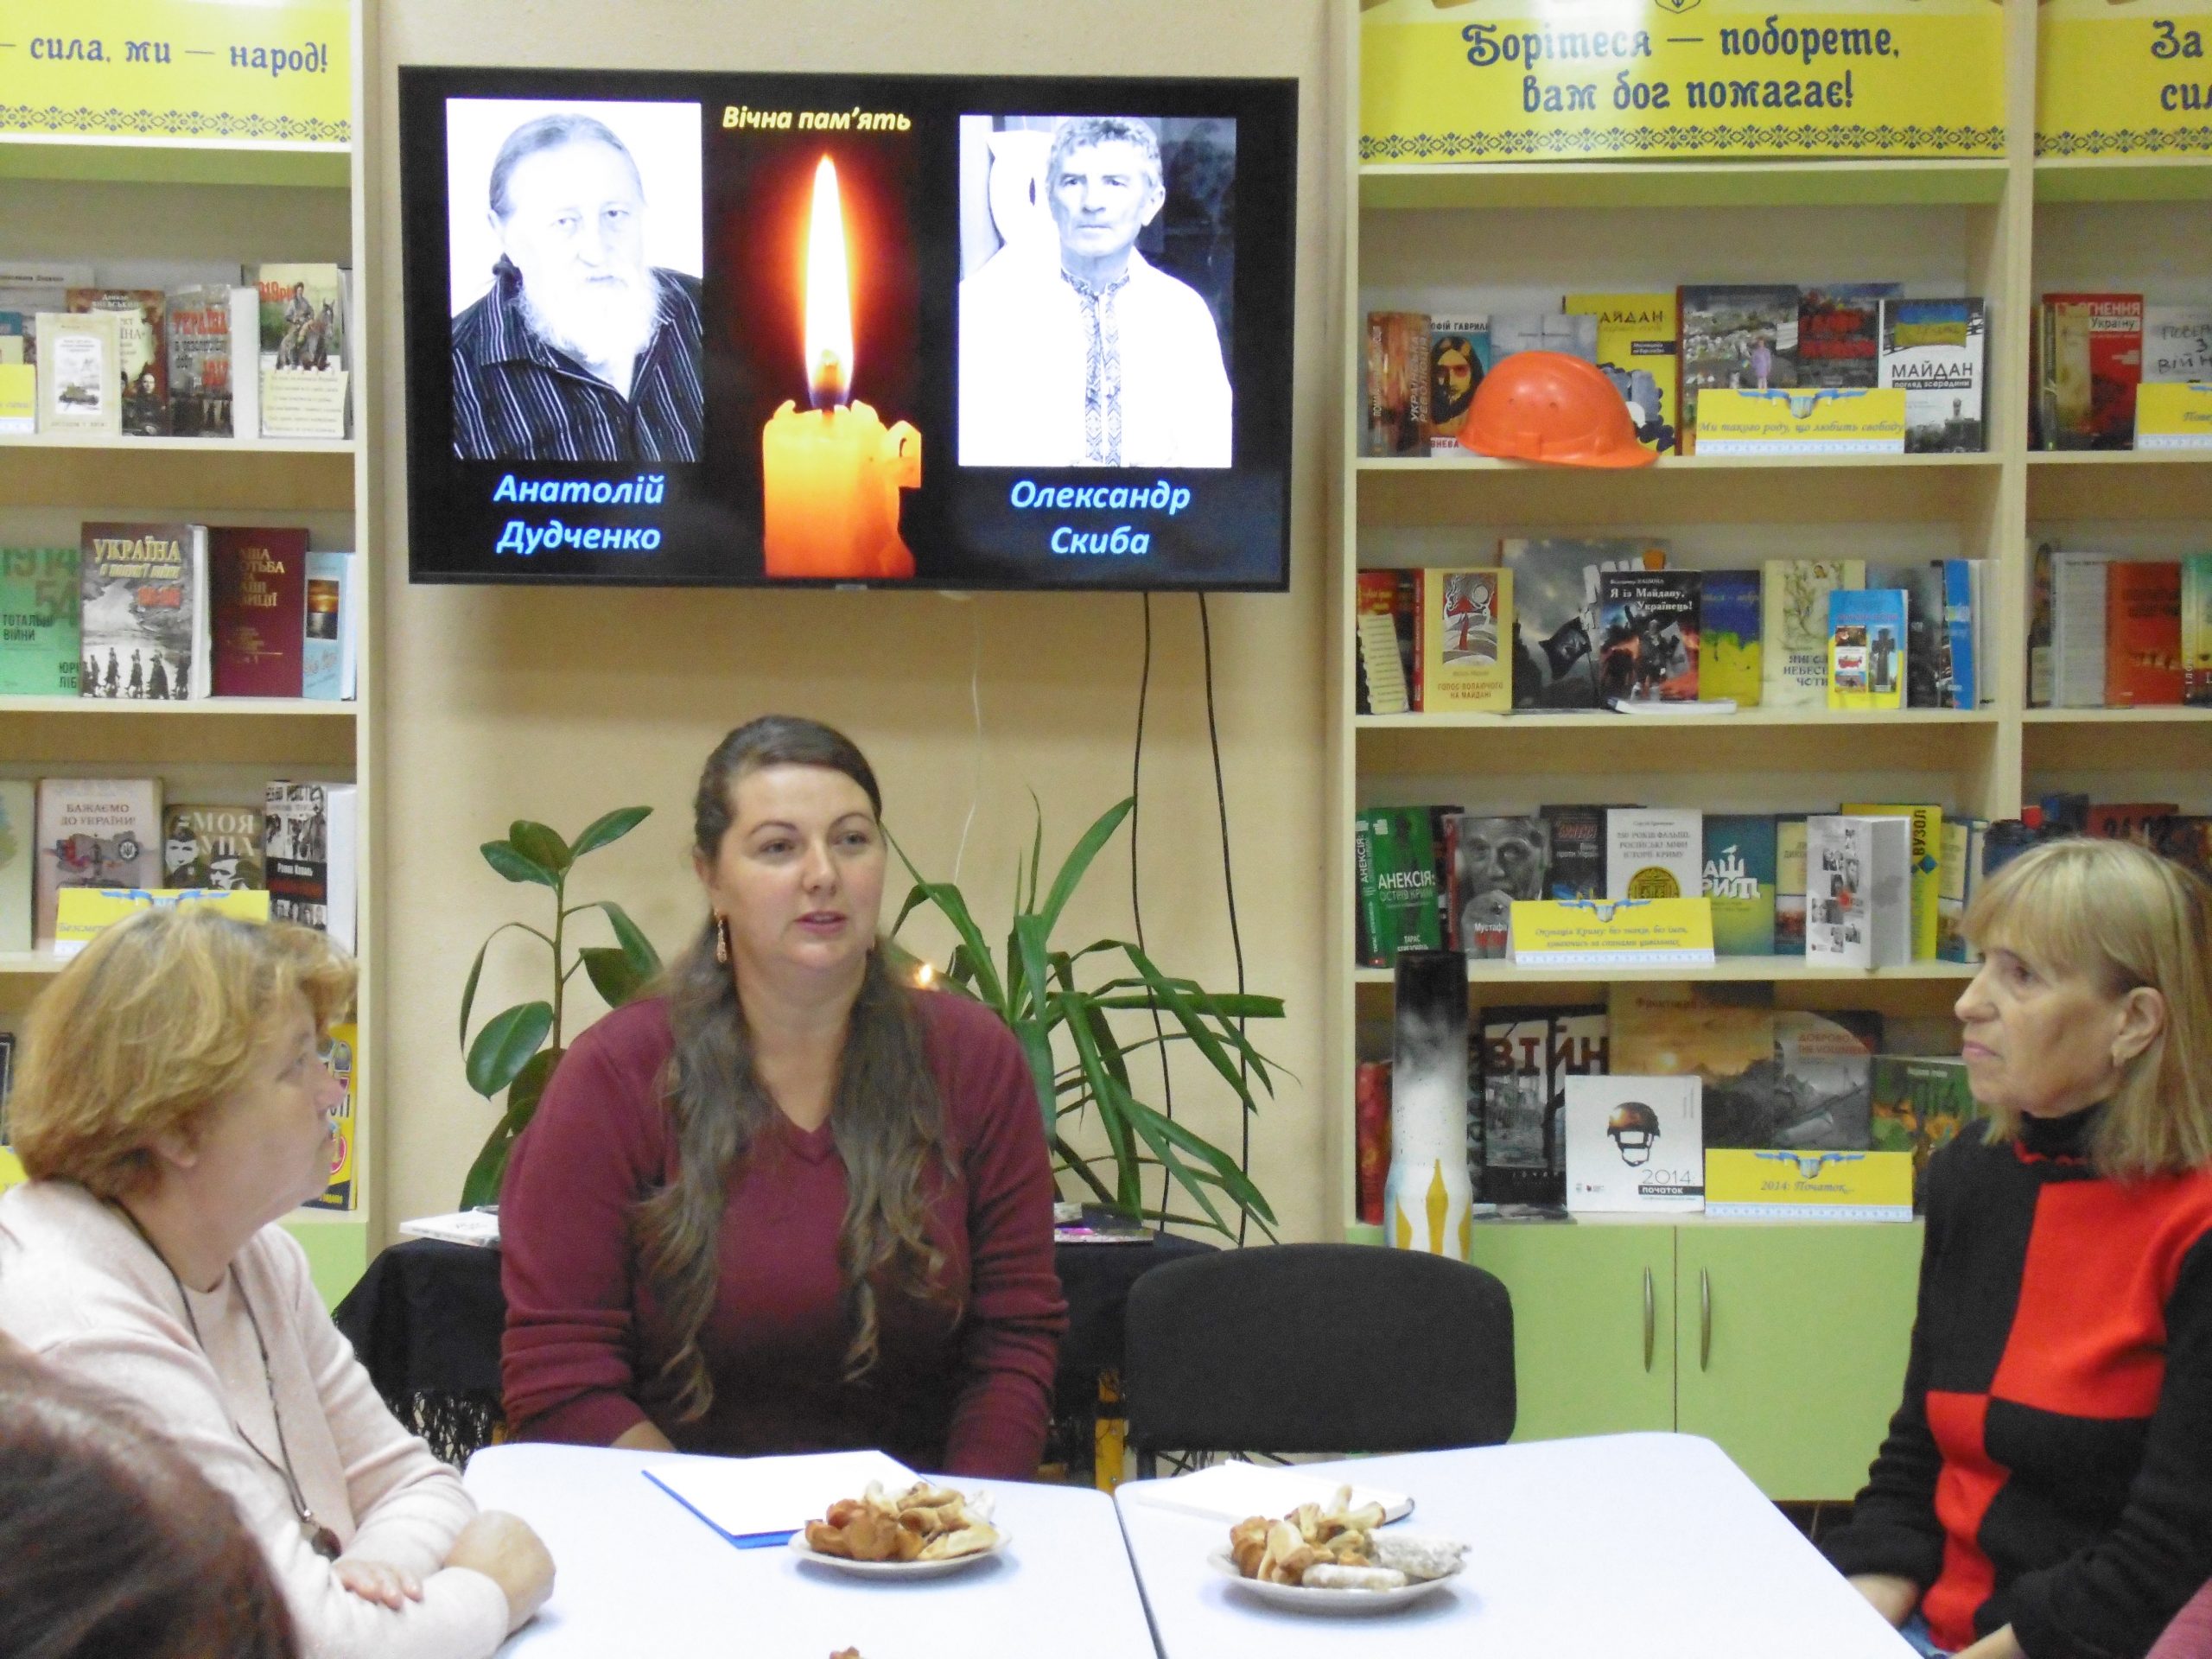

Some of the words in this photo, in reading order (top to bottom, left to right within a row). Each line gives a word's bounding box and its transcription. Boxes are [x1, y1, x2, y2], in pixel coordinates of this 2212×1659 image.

[1461, 23, 1652, 69] Борітеся
[1719, 15, 1900, 65] поборете,
[2151, 19, 2203, 59] За
[124, 40, 172, 64] ми
[229, 41, 329, 78] народ!
[1522, 74, 1597, 113] вам
[1612, 69, 1670, 111] бог
[1686, 69, 1854, 110] помагає!
[722, 105, 792, 129] Вічна
[1453, 321, 1489, 331] ГАВРИЛ
[1600, 310, 1663, 324] АЙДАН
[2090, 316, 2136, 331] Україну
[1891, 359, 1973, 379] МАЙДАН
[493, 474, 664, 504] Анатолій
[1010, 480, 1191, 516] Олександр
[92, 535, 181, 563] УКРАЇНА
[495, 519, 661, 555] Дудченко
[1050, 524, 1150, 555] Скиба
[1611, 588, 1618, 598] Я
[1637, 601, 1693, 612] Українець!
[66, 803, 130, 813] БАЖАЄМО
[192, 810, 256, 836] МОЯ
[1913, 809, 1927, 855] ВУЗОЛ
[1702, 853, 1745, 879] АШ
[1378, 870, 1436, 890] АНЕКСІЯ:
[1702, 876, 1762, 900] РИМ
[1484, 1025, 1611, 1077] ВІЙН
